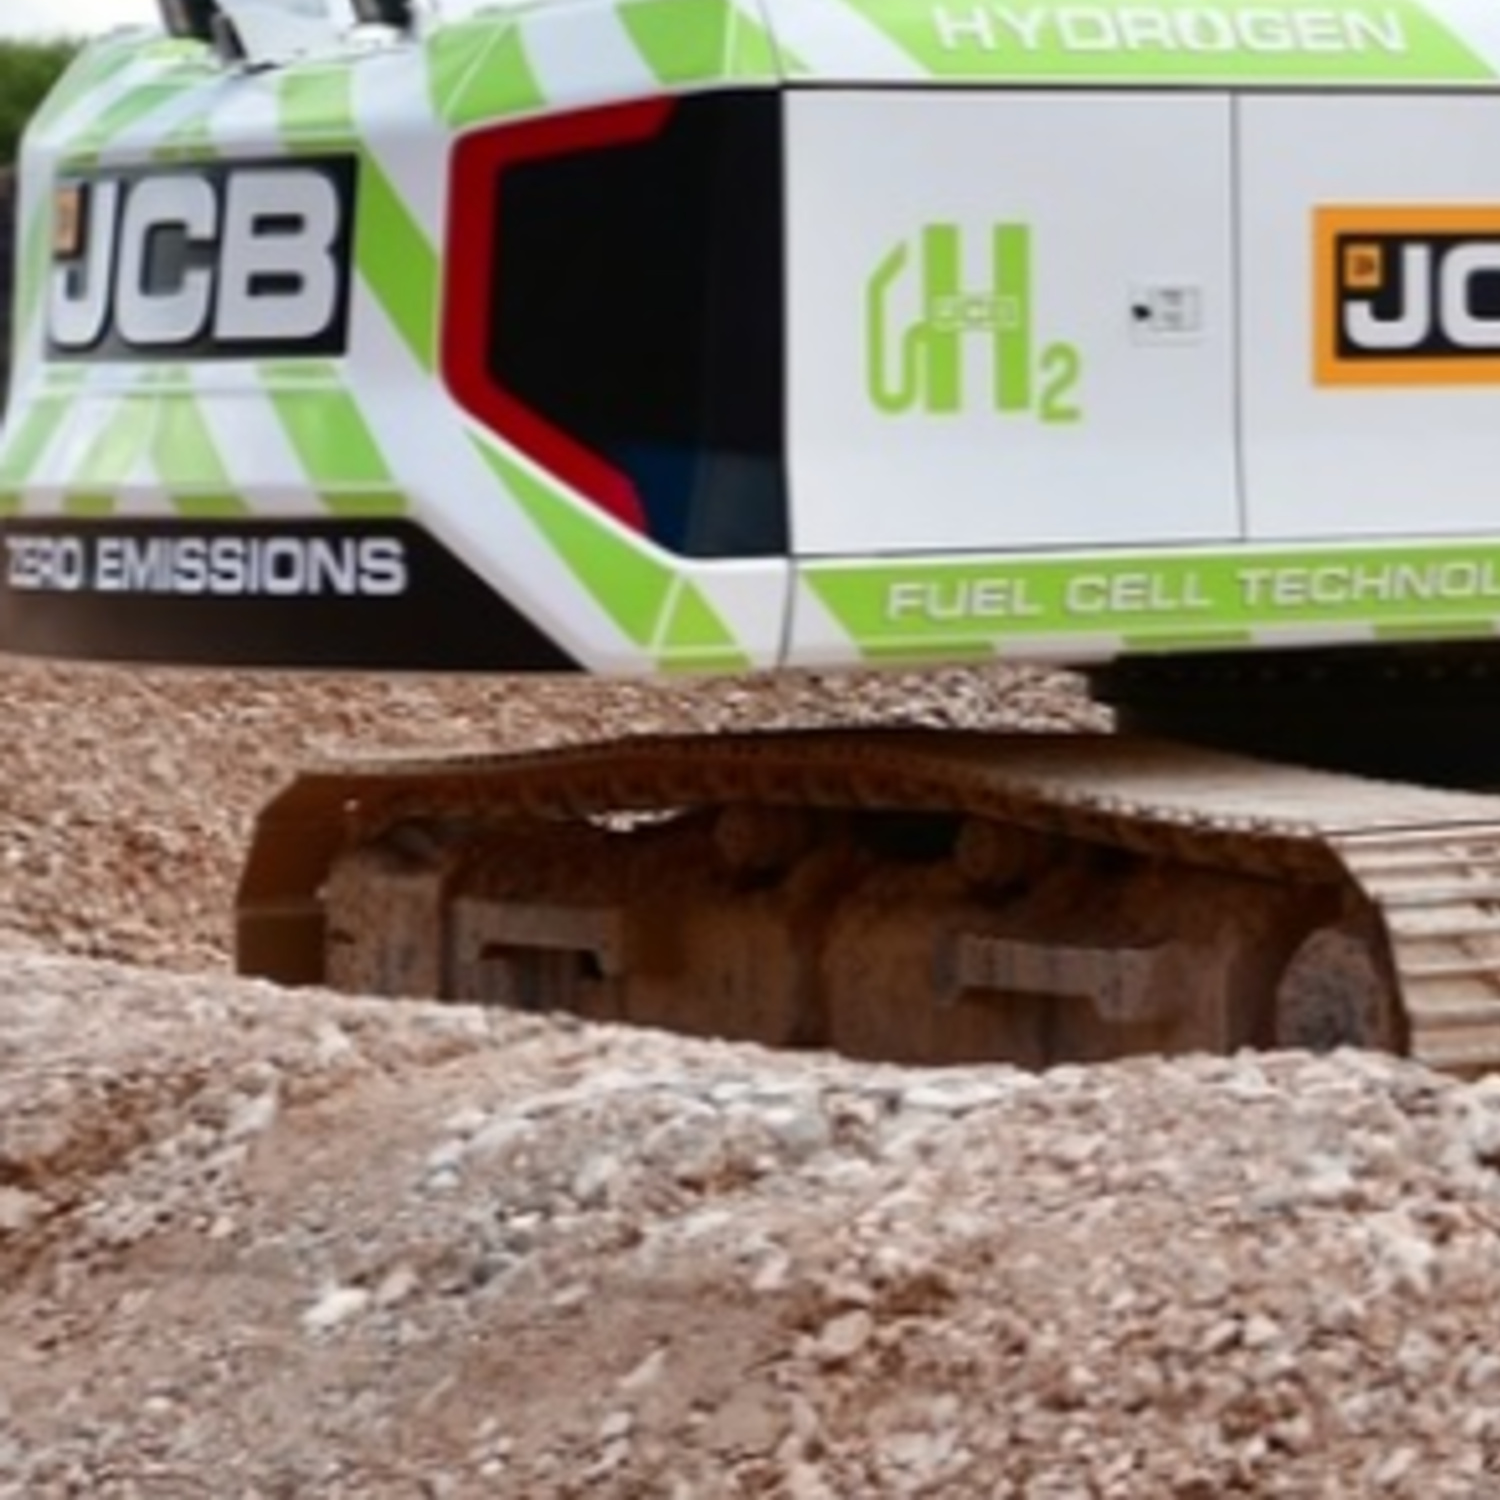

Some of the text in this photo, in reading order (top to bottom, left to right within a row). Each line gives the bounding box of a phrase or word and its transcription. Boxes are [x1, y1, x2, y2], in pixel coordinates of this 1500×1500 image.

[931, 4, 1408, 53] HYDROGEN
[50, 168, 339, 344] JCB
[96, 537, 407, 595] EMISSIONS
[886, 579, 1042, 620] FUEL
[1066, 572, 1212, 613] CELL
